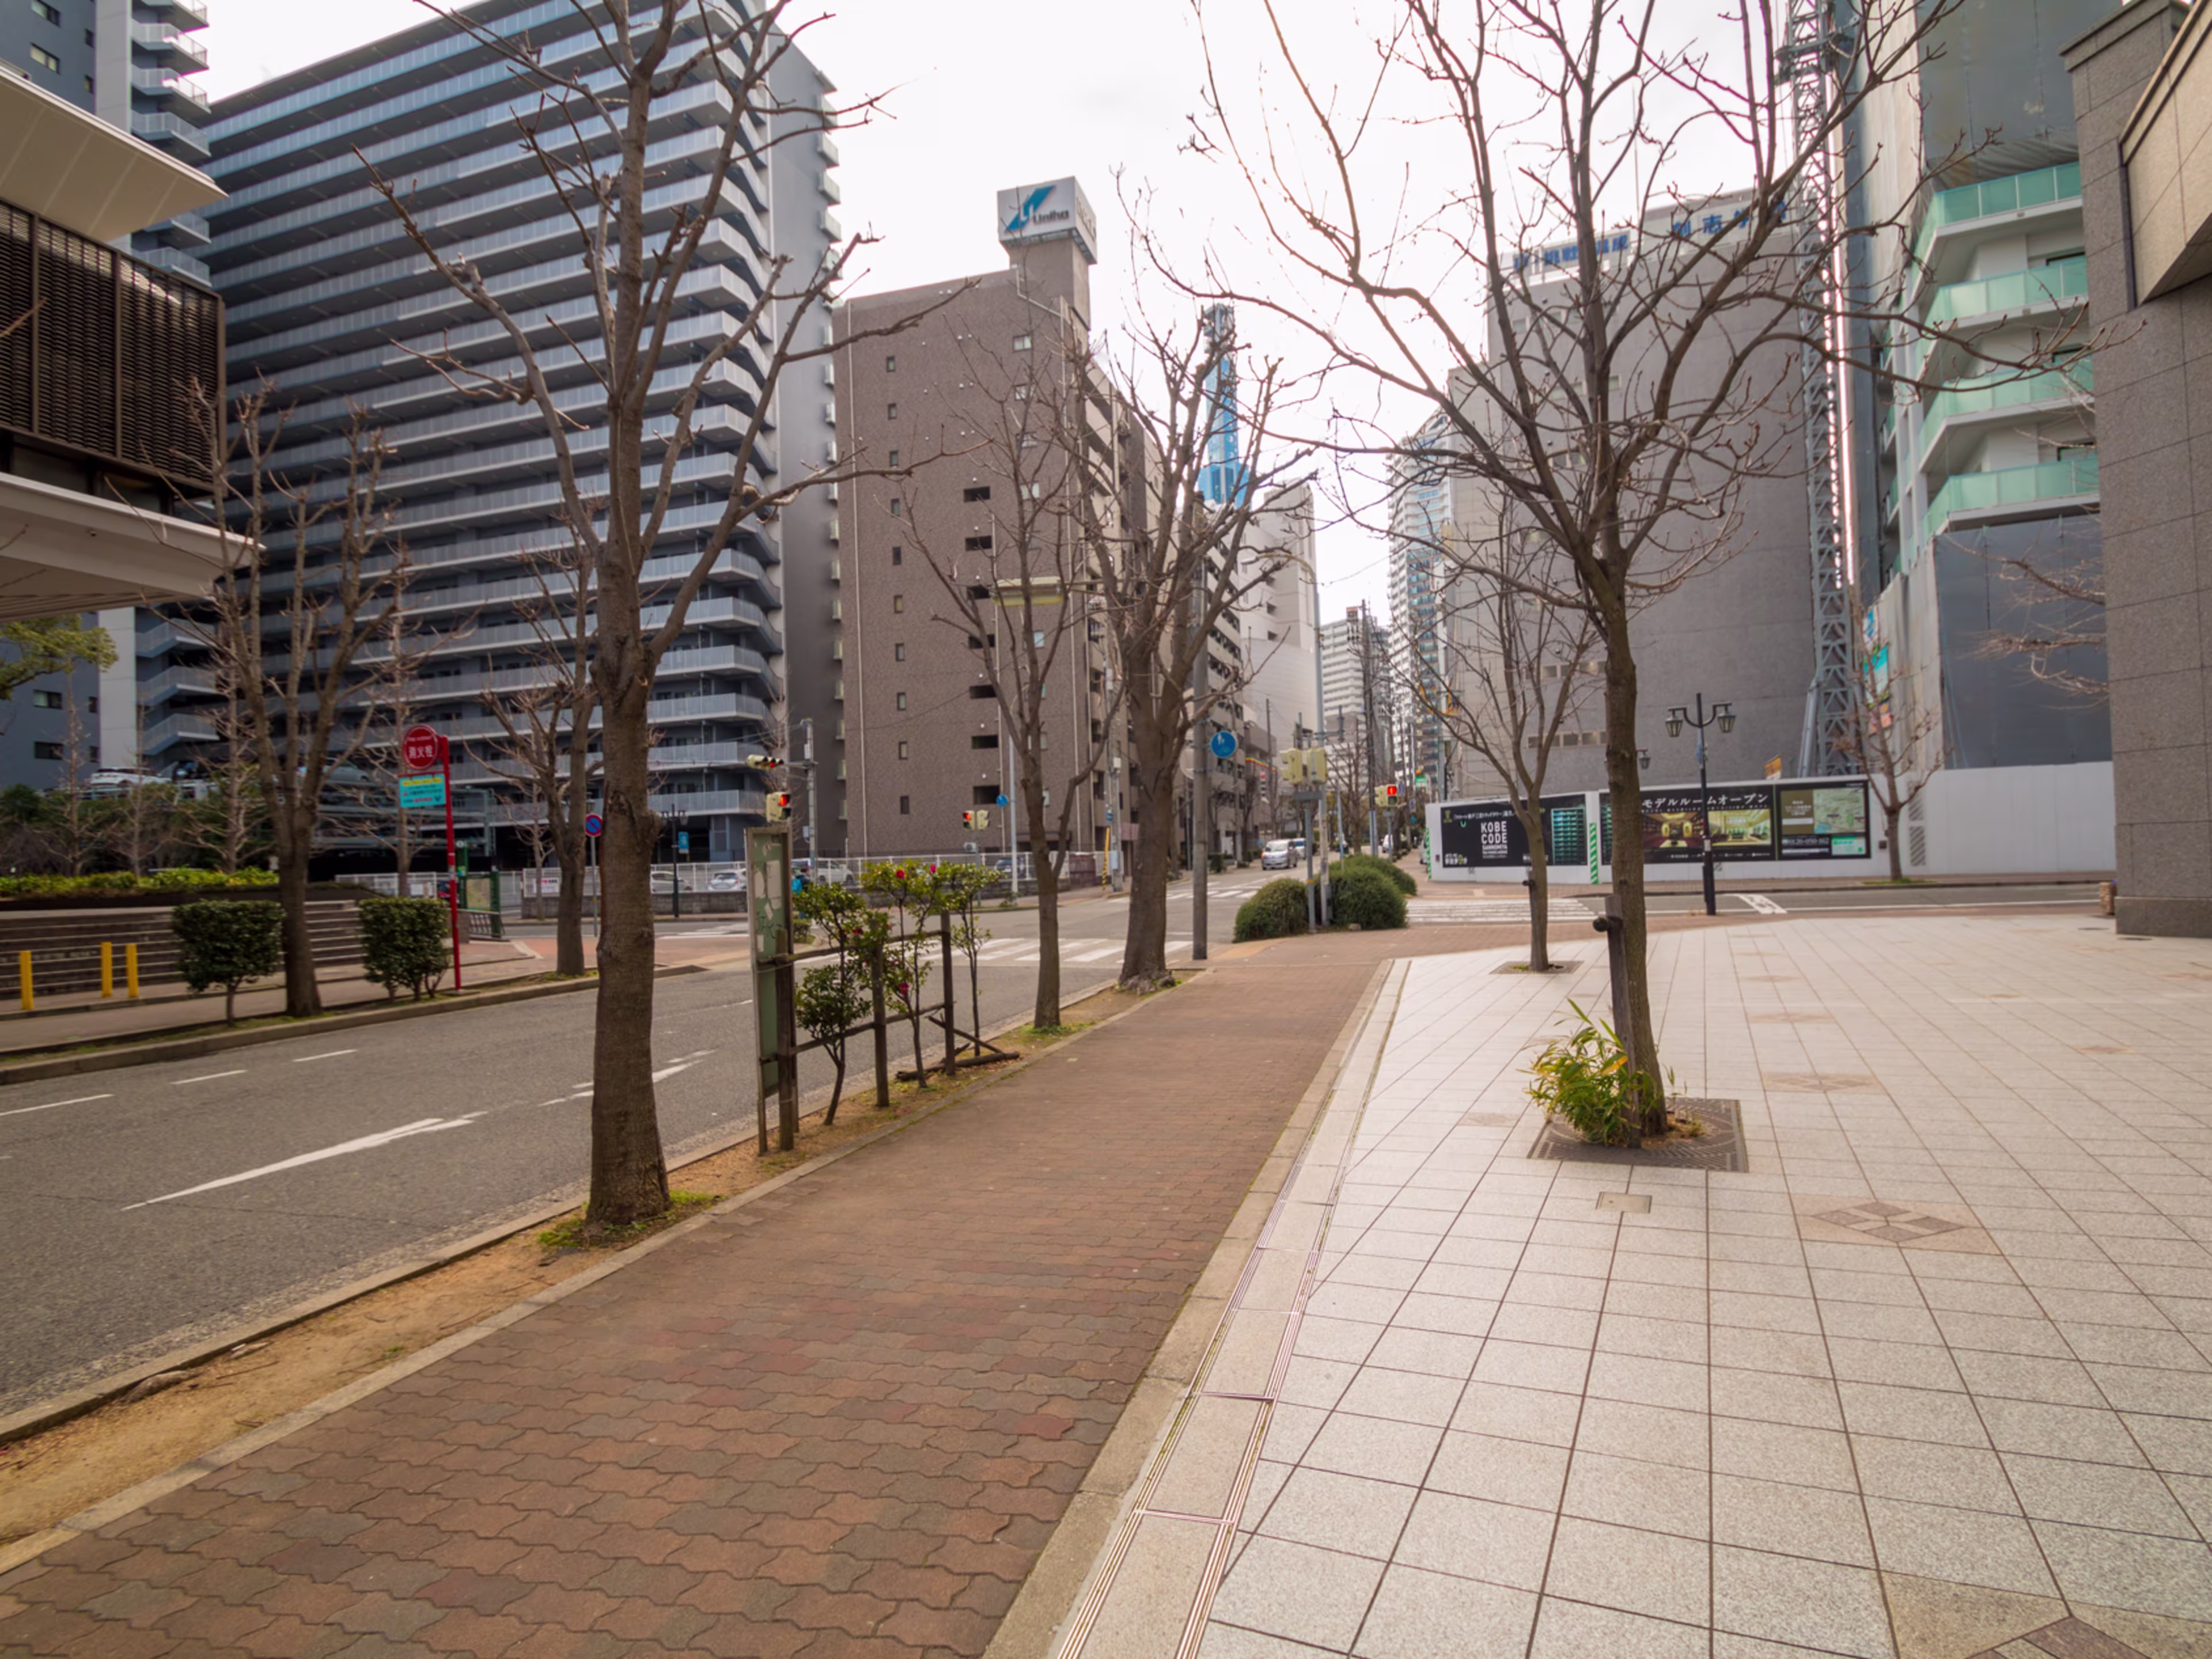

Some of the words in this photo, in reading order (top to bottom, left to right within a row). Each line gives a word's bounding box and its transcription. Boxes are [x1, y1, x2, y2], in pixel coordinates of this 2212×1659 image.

[408, 745, 434, 759] 消火栓
[1481, 821, 1507, 833] KOBE
[1481, 833, 1508, 844] CODE
